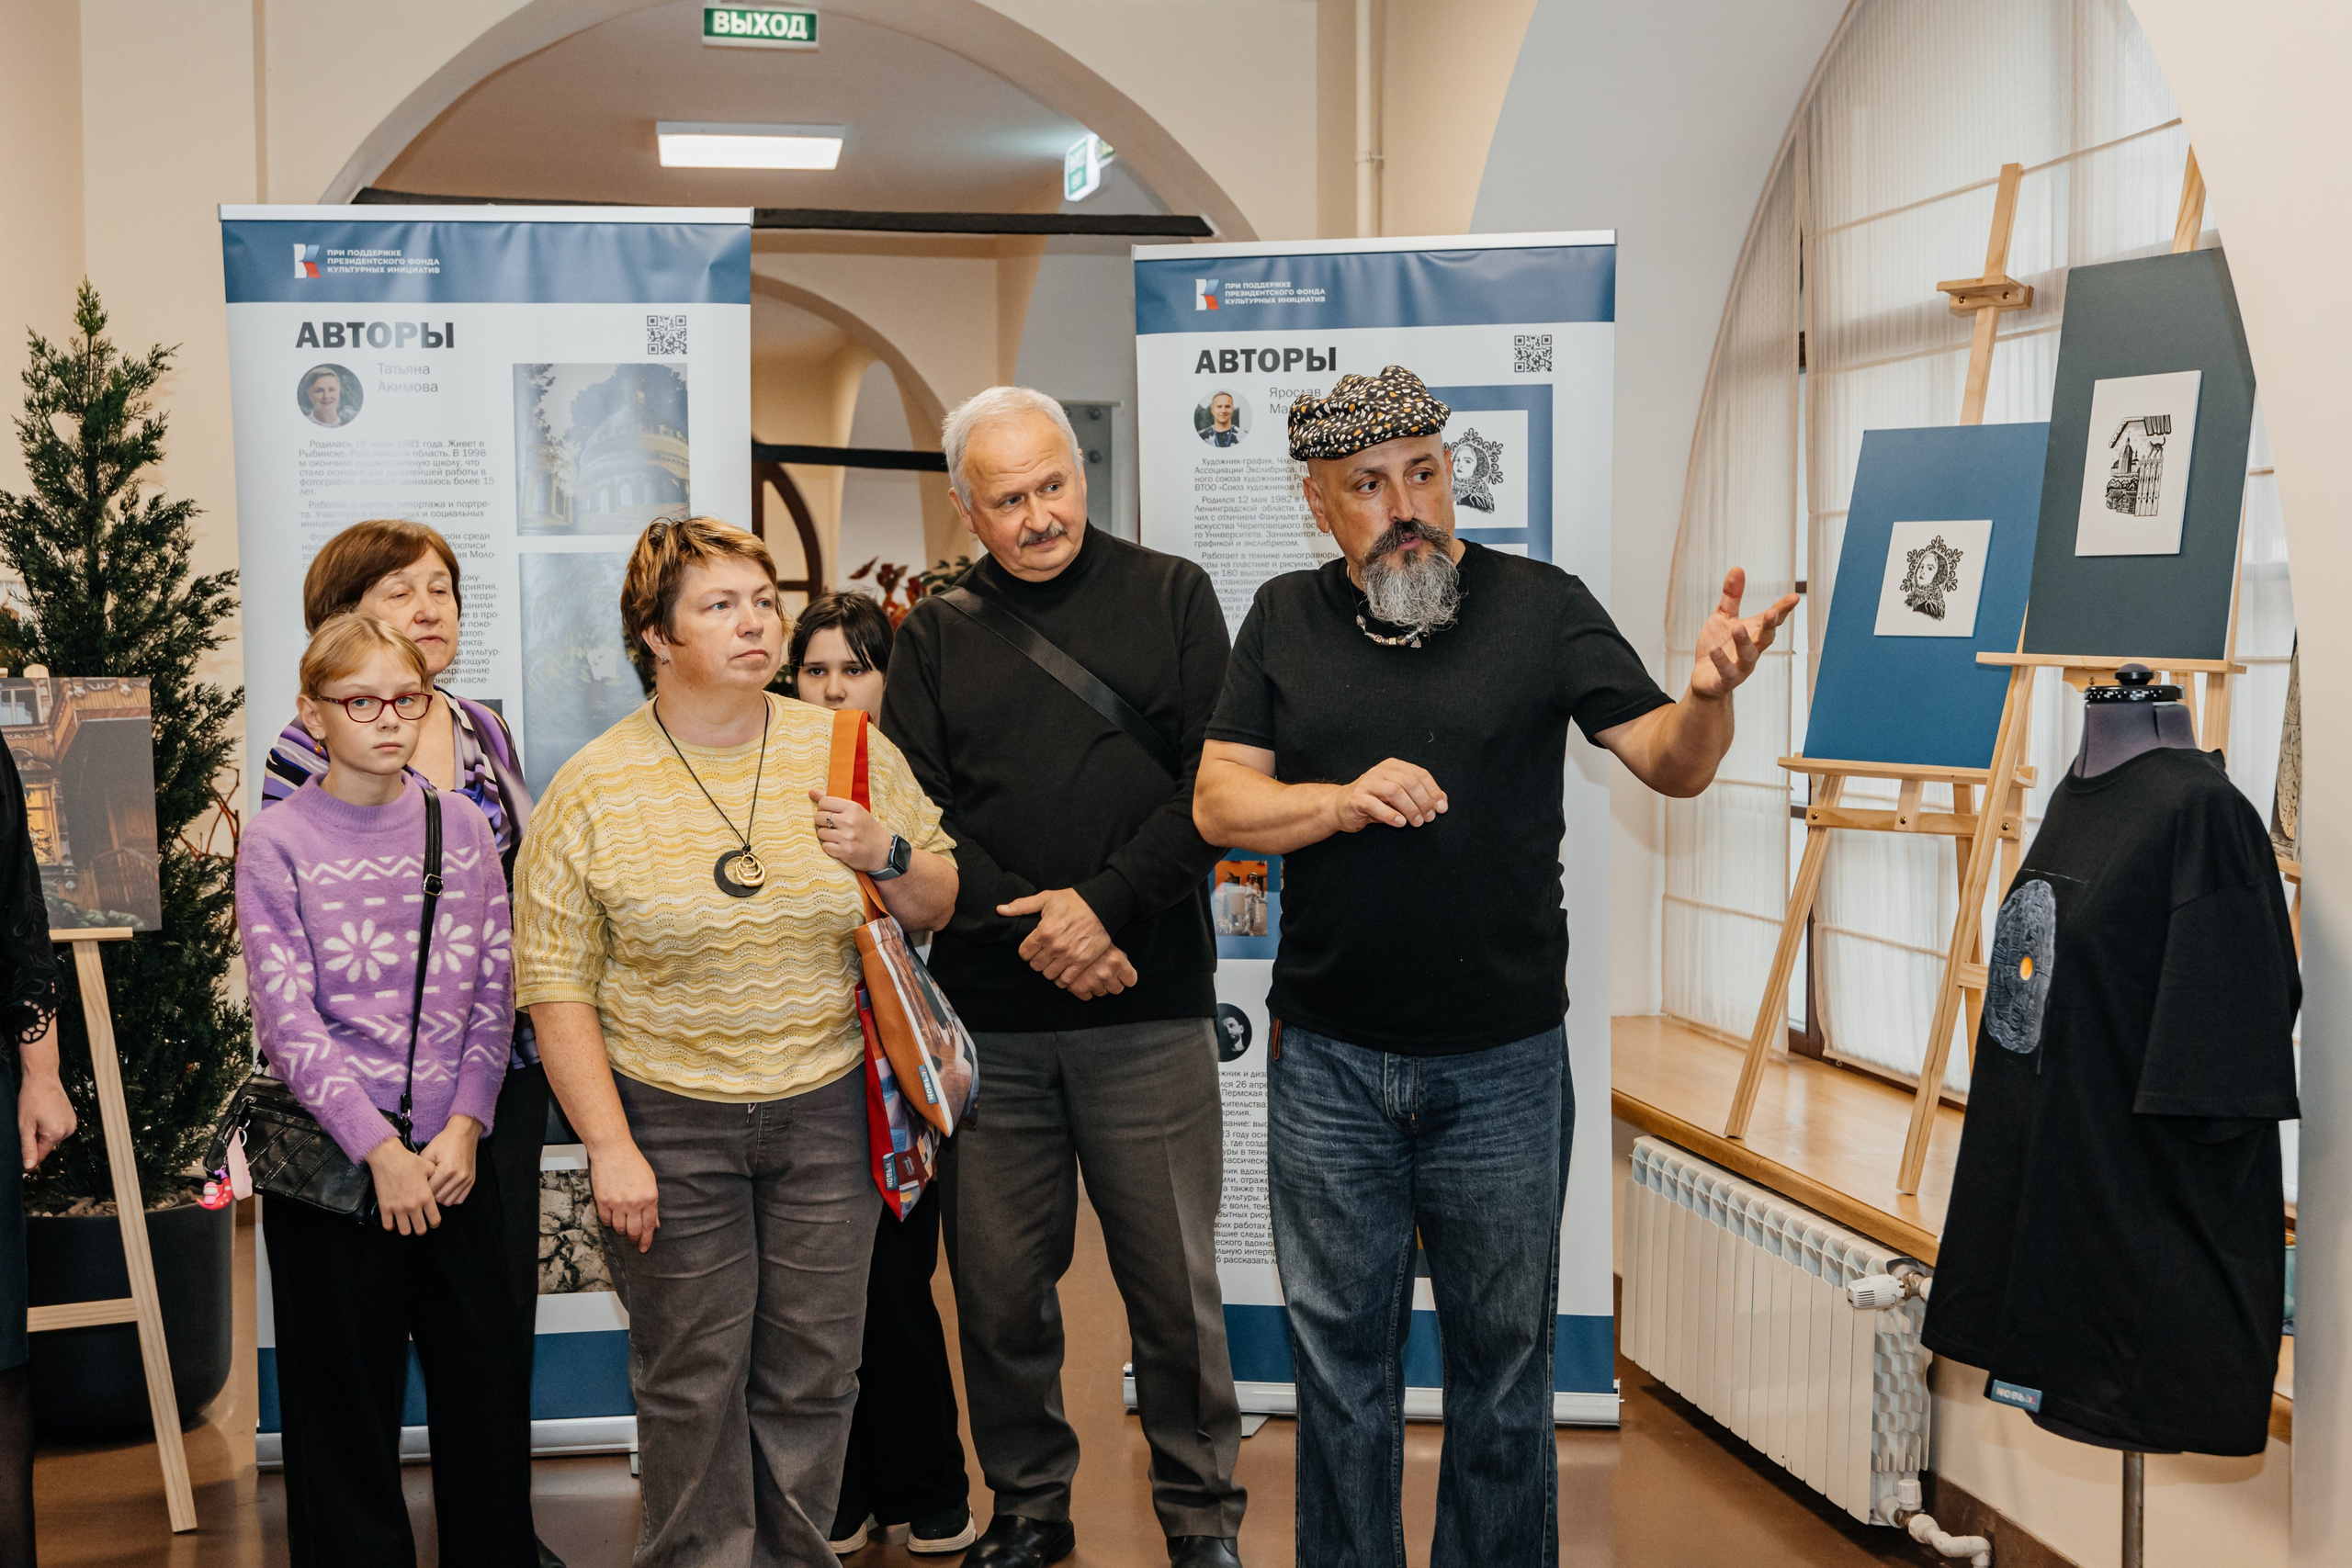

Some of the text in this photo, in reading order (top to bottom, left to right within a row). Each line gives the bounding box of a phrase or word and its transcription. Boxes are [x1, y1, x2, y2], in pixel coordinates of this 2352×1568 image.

[713, 11, 808, 39] ВЫХОД
[387, 266, 441, 275] ИНИЦИАТИВ
[1243, 281, 1292, 289] ПОДДЕРЖКЕ
[1225, 289, 1295, 298] ПРЕЗИДЕНТСКОГО
[1278, 296, 1326, 304] ИНИЦИАТИВ
[296, 321, 455, 349] АВТОРЫ
[1194, 346, 1337, 374] АВТОРЫ
[377, 362, 431, 376] Татьяна
[377, 379, 439, 394] Акимова
[310, 440, 353, 449] Родилась
[397, 440, 420, 448] 1981
[423, 441, 446, 449] года.
[447, 440, 477, 448] Живет
[299, 450, 347, 458] Рыбинске,
[462, 449, 489, 457] 1998-
[433, 459, 462, 468] школу,
[445, 468, 479, 477] работы
[483, 477, 494, 485] 15
[397, 501, 446, 510] репортажа
[457, 501, 490, 510] портре-
[1194, 504, 1257, 513] Ленинградской
[430, 510, 484, 519] социальных
[1194, 523, 1235, 533] искусства
[1237, 522, 1300, 531] Череповецкого
[1205, 531, 1263, 539] Университета.
[1194, 539, 1234, 547] графикой
[1243, 539, 1300, 547] экслибрисом.
[1236, 1080, 1247, 1089] 26
[1222, 1089, 1262, 1098] Пермская
[1233, 1222, 1266, 1230] работах
